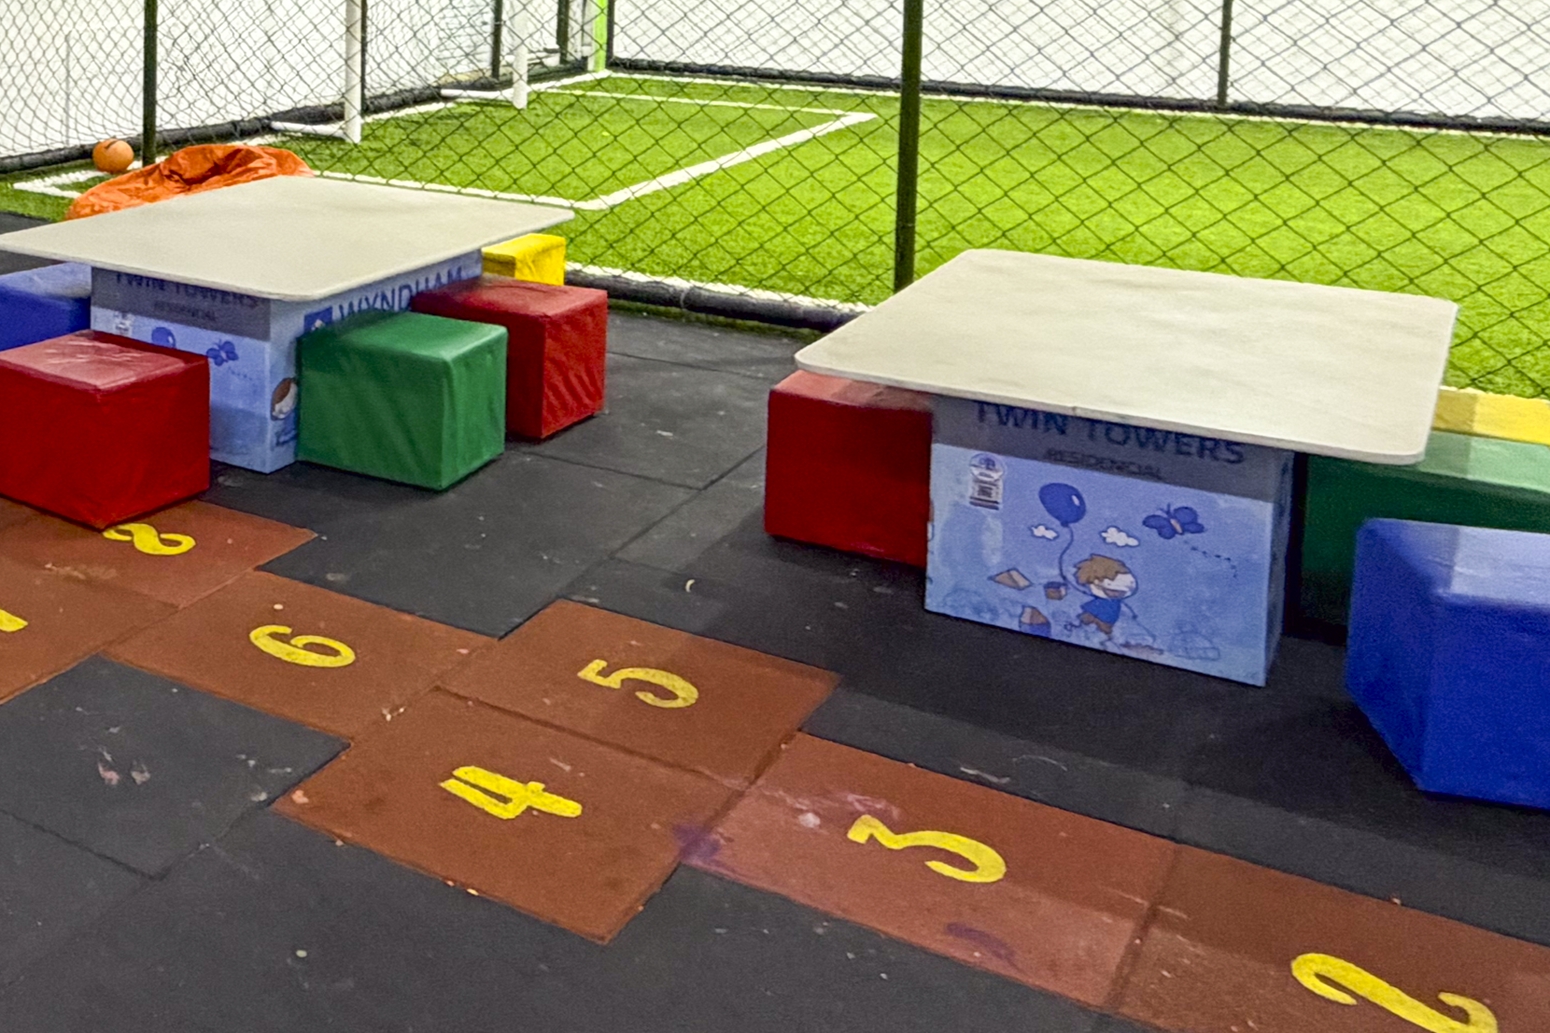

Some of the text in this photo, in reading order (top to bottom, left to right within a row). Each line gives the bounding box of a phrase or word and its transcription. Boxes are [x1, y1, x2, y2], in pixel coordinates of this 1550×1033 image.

[974, 400, 1246, 464] TWIN TOWERS
[103, 523, 196, 556] 8
[250, 625, 356, 668] 6
[580, 659, 698, 709] 5
[440, 765, 582, 820] 4
[848, 817, 1006, 884] 3
[1291, 953, 1498, 1033] 2
